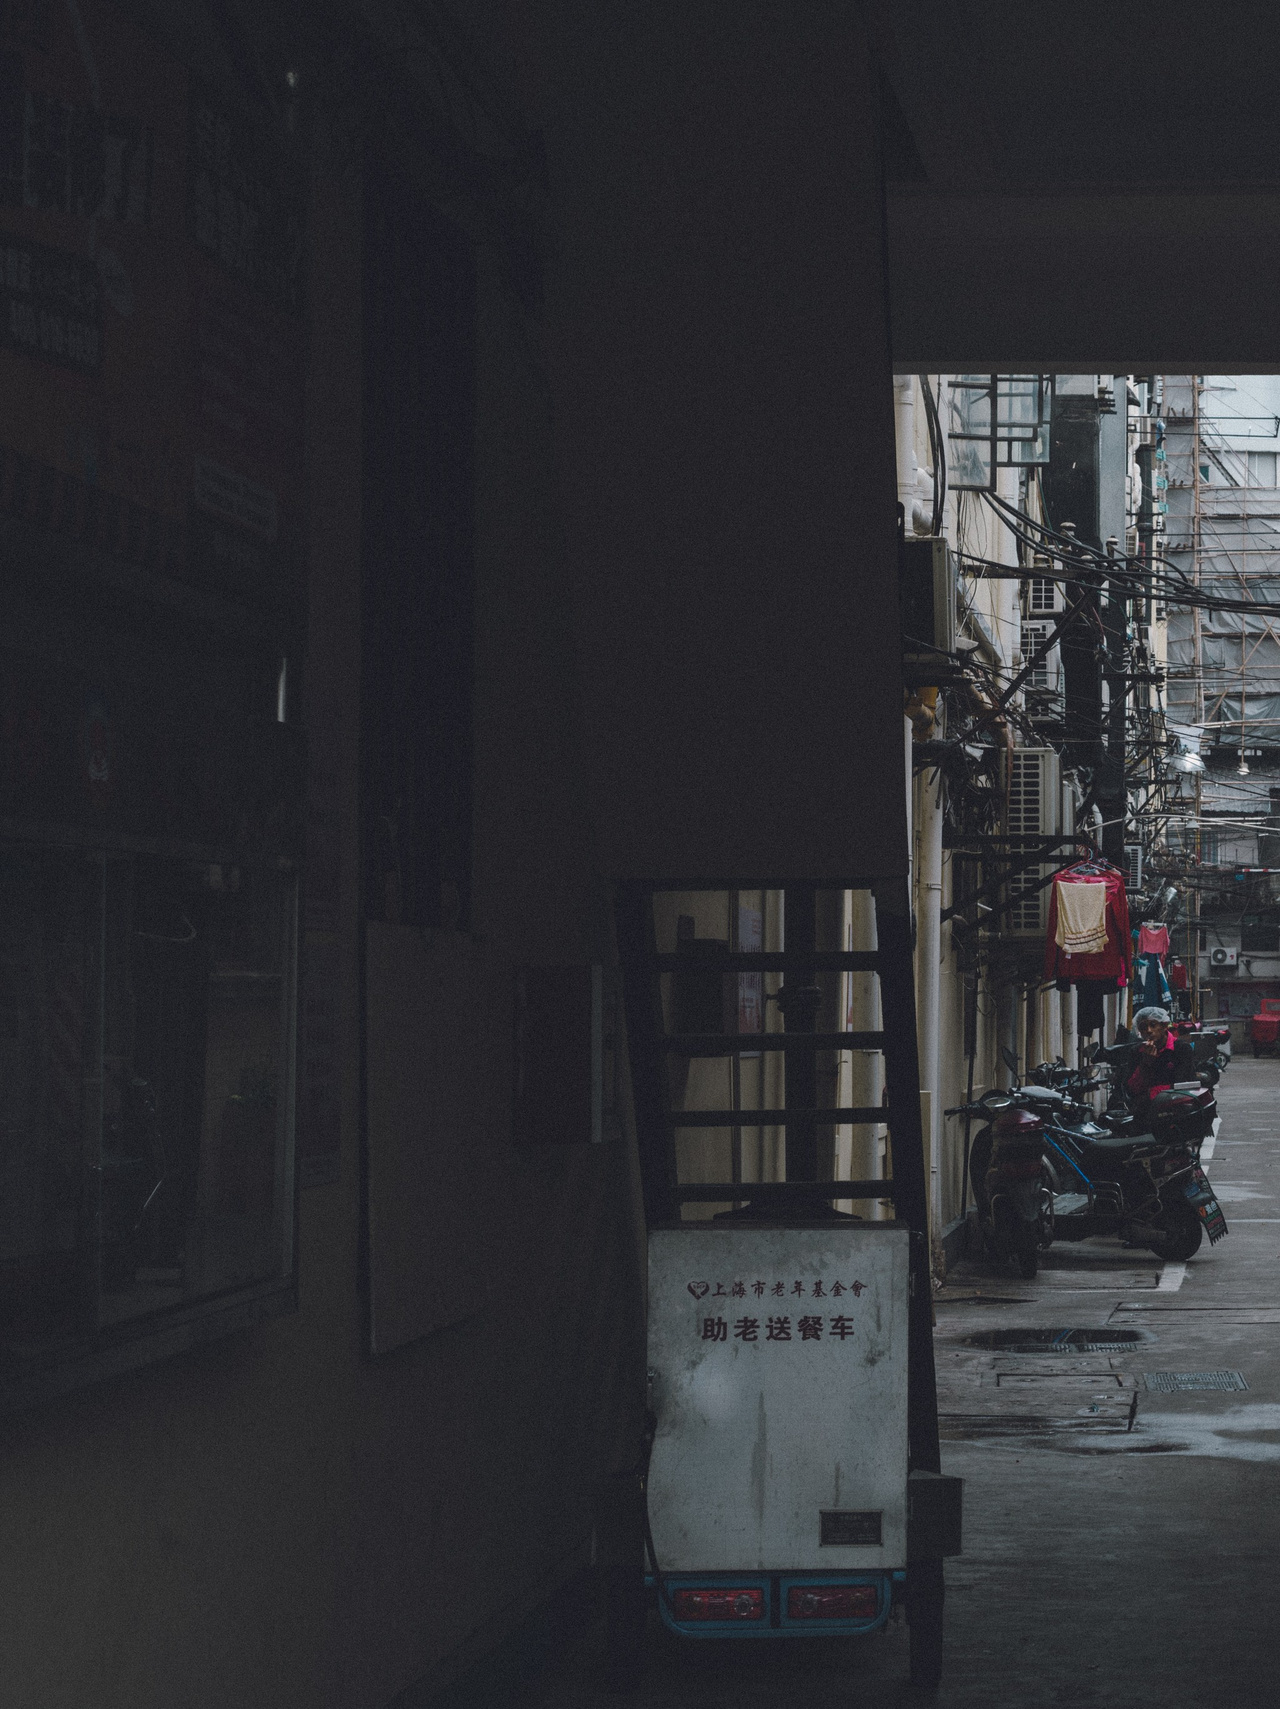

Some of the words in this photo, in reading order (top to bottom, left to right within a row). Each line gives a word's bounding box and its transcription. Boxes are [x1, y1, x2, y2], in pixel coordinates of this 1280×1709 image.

[712, 1279, 868, 1299] 上海市老年基金會
[701, 1315, 854, 1341] 助老送餐车
